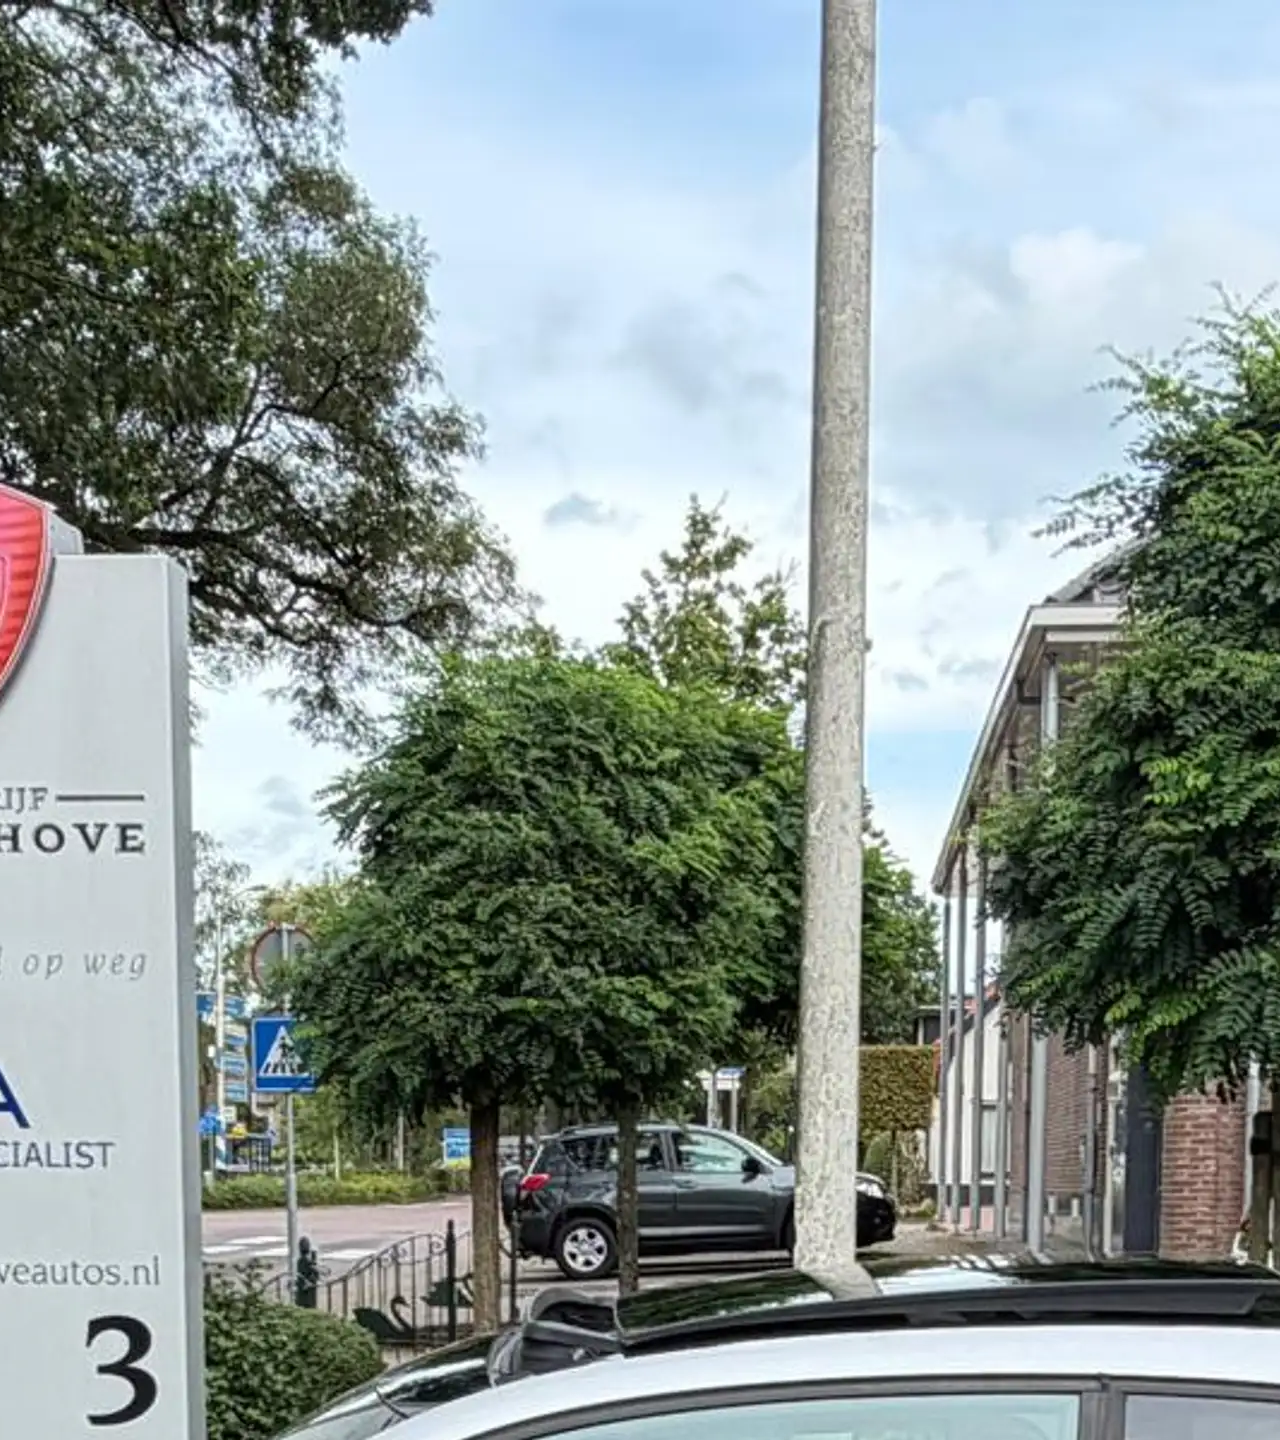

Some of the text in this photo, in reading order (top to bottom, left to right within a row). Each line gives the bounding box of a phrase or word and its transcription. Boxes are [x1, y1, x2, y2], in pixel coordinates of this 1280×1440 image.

[22, 952, 64, 981] op
[83, 951, 148, 982] weg
[84, 1314, 158, 1427] 3
